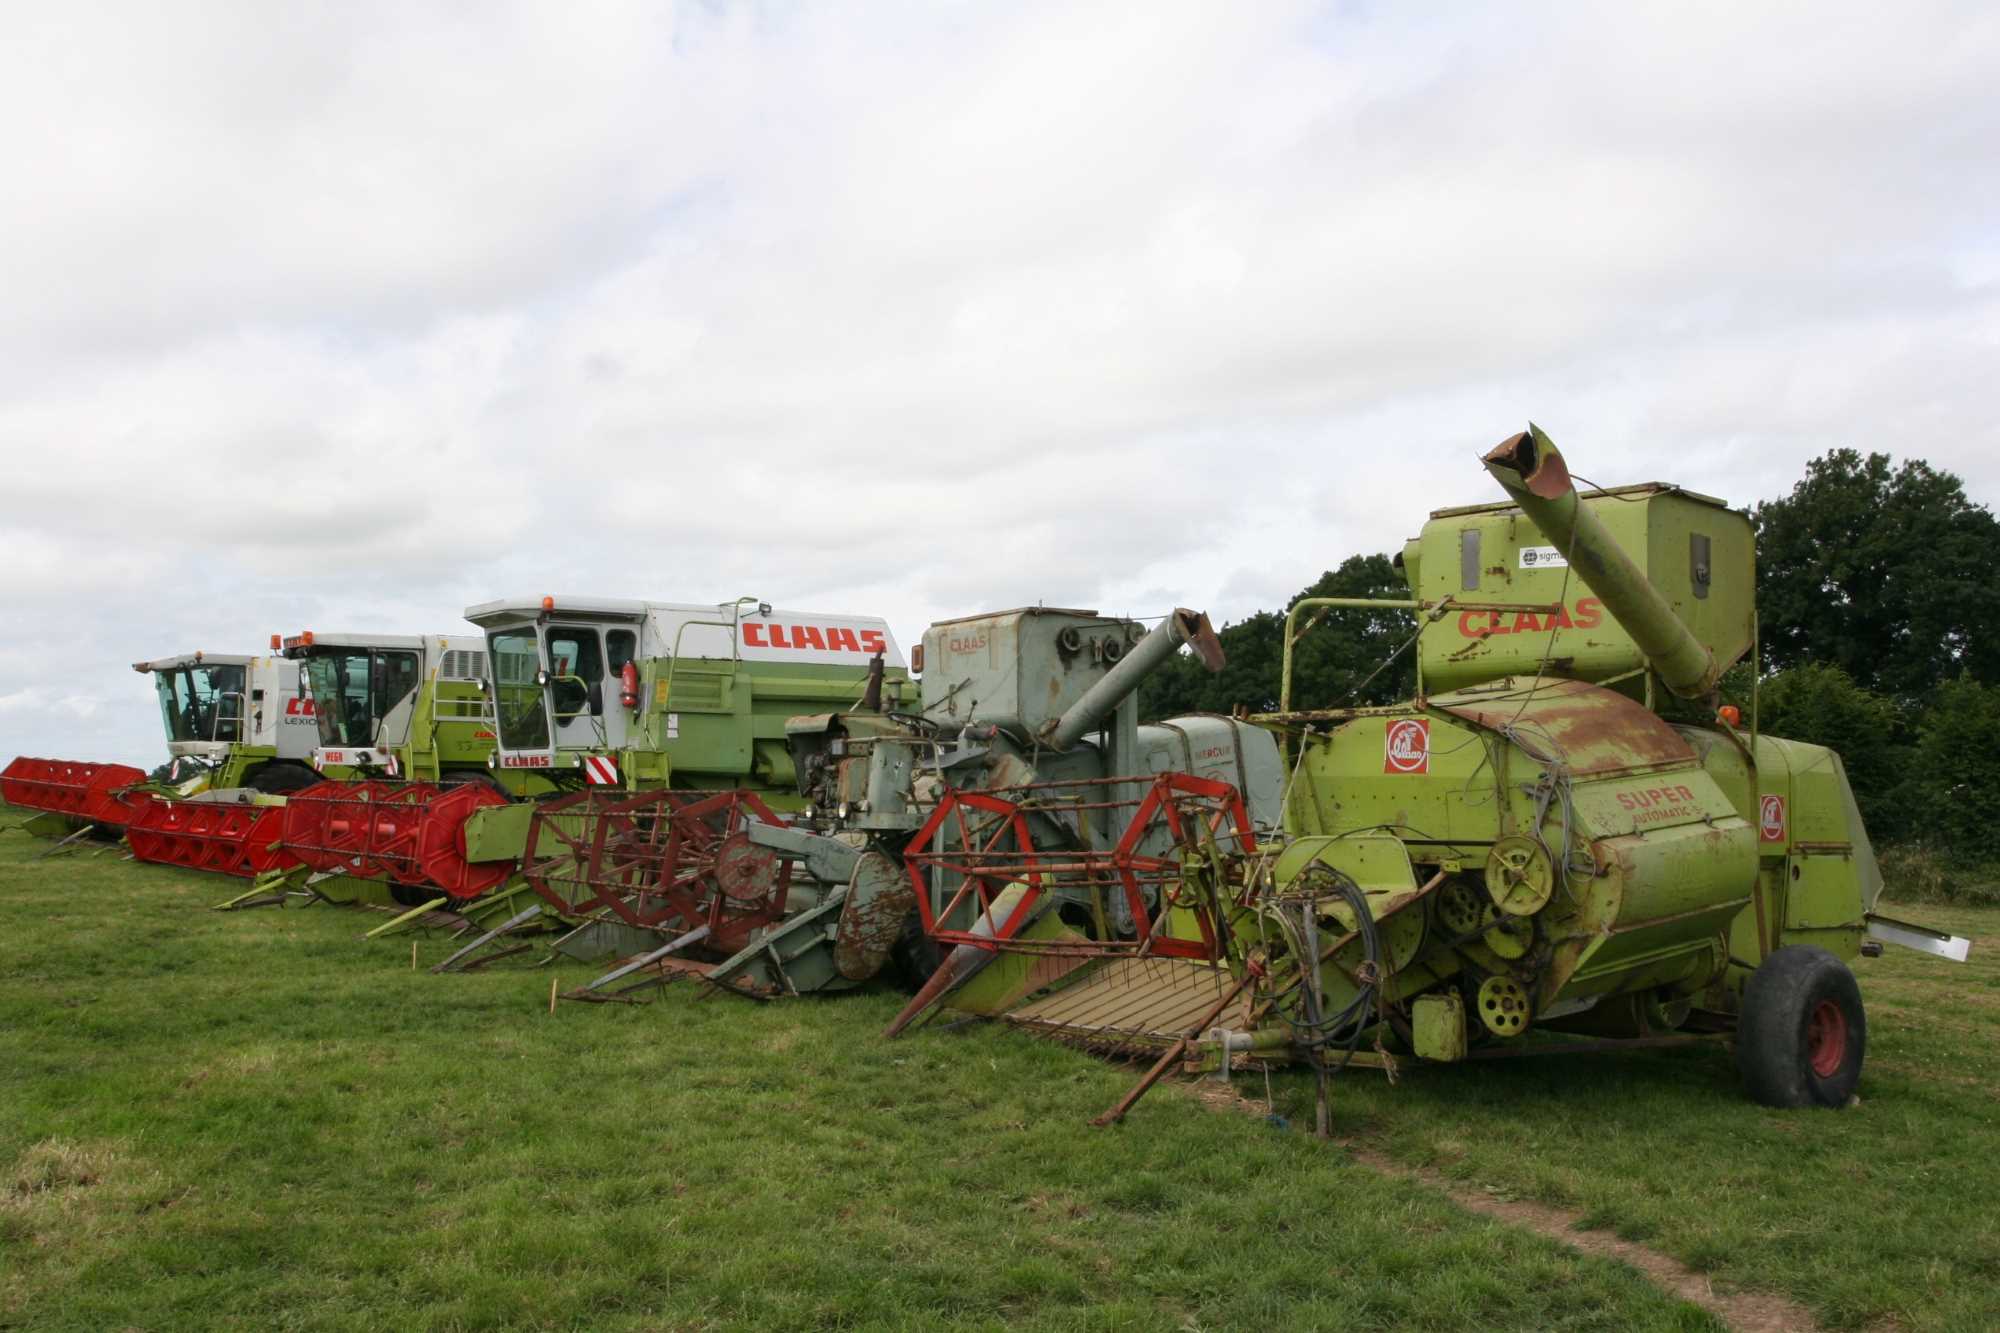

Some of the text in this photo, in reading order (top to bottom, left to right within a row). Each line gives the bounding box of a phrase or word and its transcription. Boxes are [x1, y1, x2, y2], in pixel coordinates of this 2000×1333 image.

[1539, 551, 1562, 562] sigm
[1458, 598, 1603, 638] CLAAS
[742, 622, 887, 653] CLAAS
[284, 718, 319, 726] LEXIO
[504, 756, 549, 767] CLAAS
[1616, 785, 1694, 810] SUPER
[1632, 807, 1691, 825] AUTOMATIC
